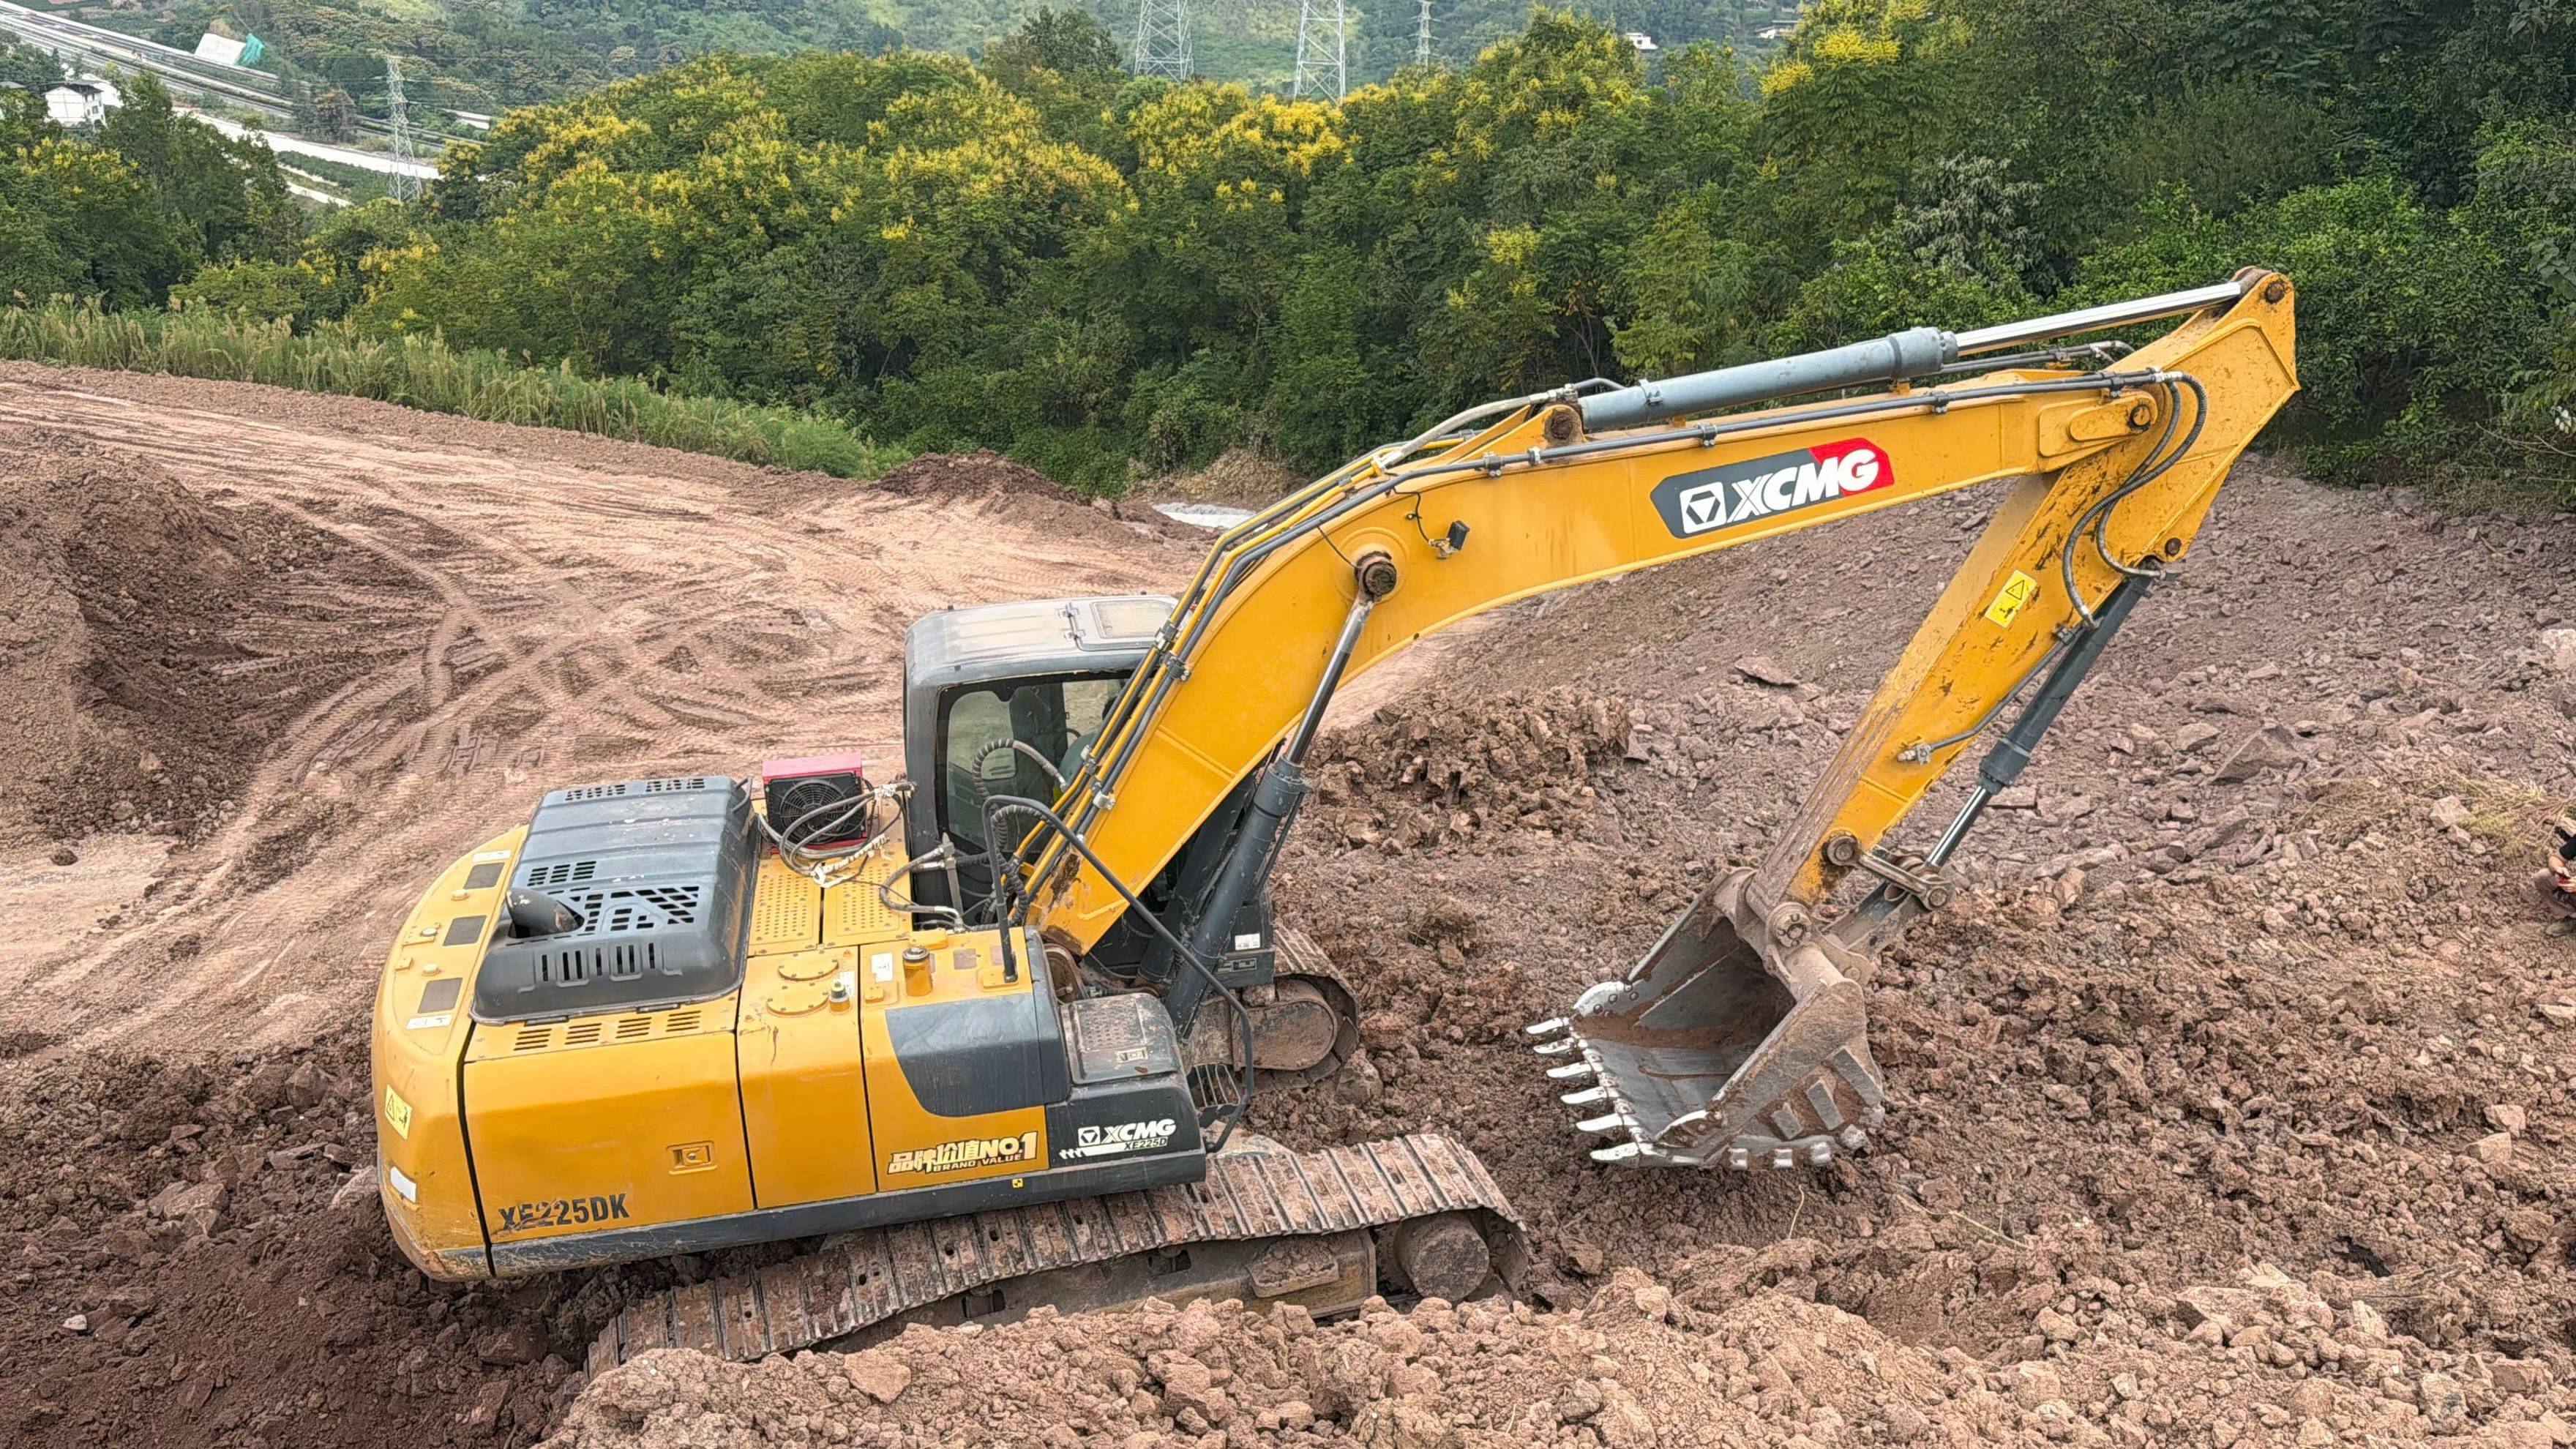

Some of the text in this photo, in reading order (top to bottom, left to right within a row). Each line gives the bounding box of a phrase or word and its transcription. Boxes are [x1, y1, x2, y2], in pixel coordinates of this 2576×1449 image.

[1728, 448, 1879, 523] XCMG
[1101, 1118, 1176, 1144] XCMG
[1124, 1137, 1167, 1150] XE225D
[981, 1153, 1022, 1165] VALUE
[498, 1193, 631, 1231] XE225DK
